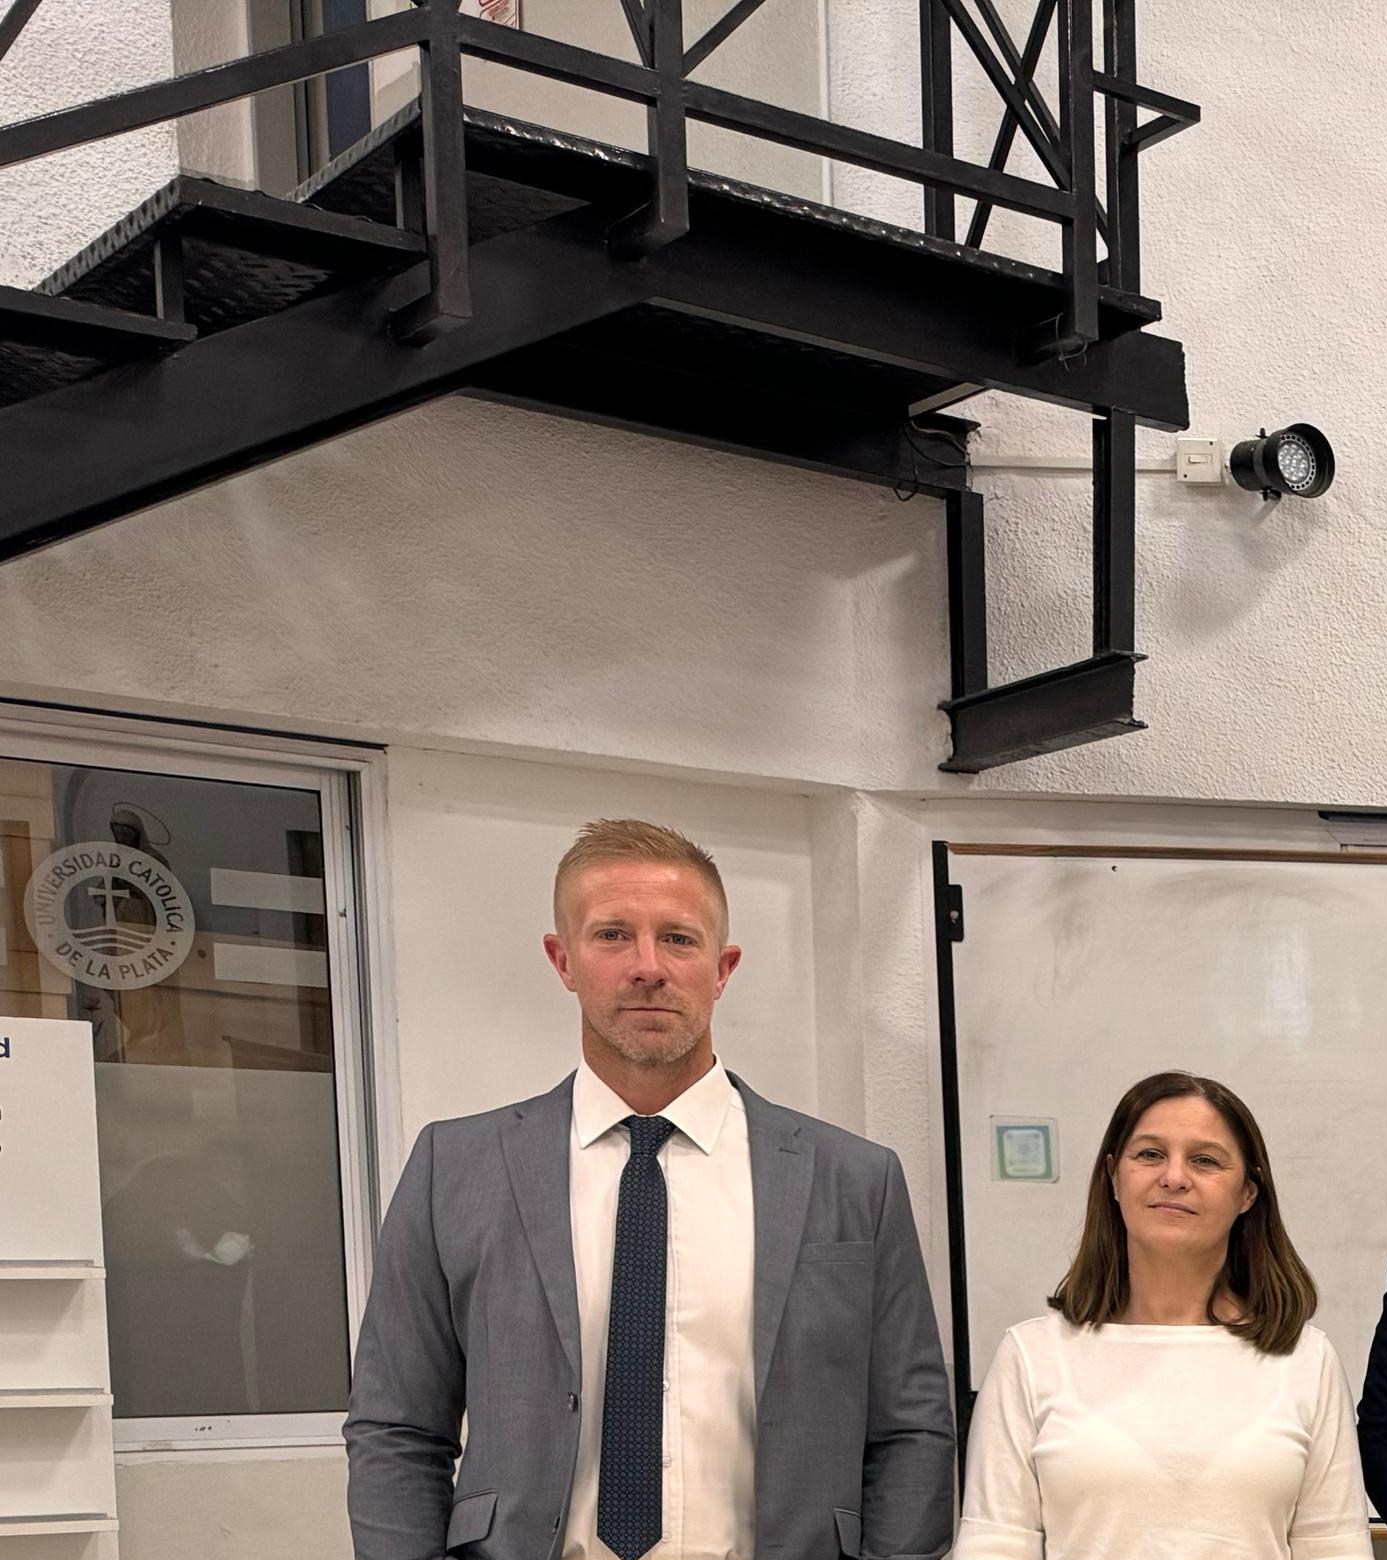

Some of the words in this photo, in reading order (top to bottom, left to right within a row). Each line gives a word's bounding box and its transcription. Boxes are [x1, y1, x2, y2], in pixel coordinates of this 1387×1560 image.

[36, 852, 121, 926] UNIVERSIDAD
[55, 941, 84, 967] DE
[85, 958, 111, 980] LA
[118, 946, 174, 980] PLATA
